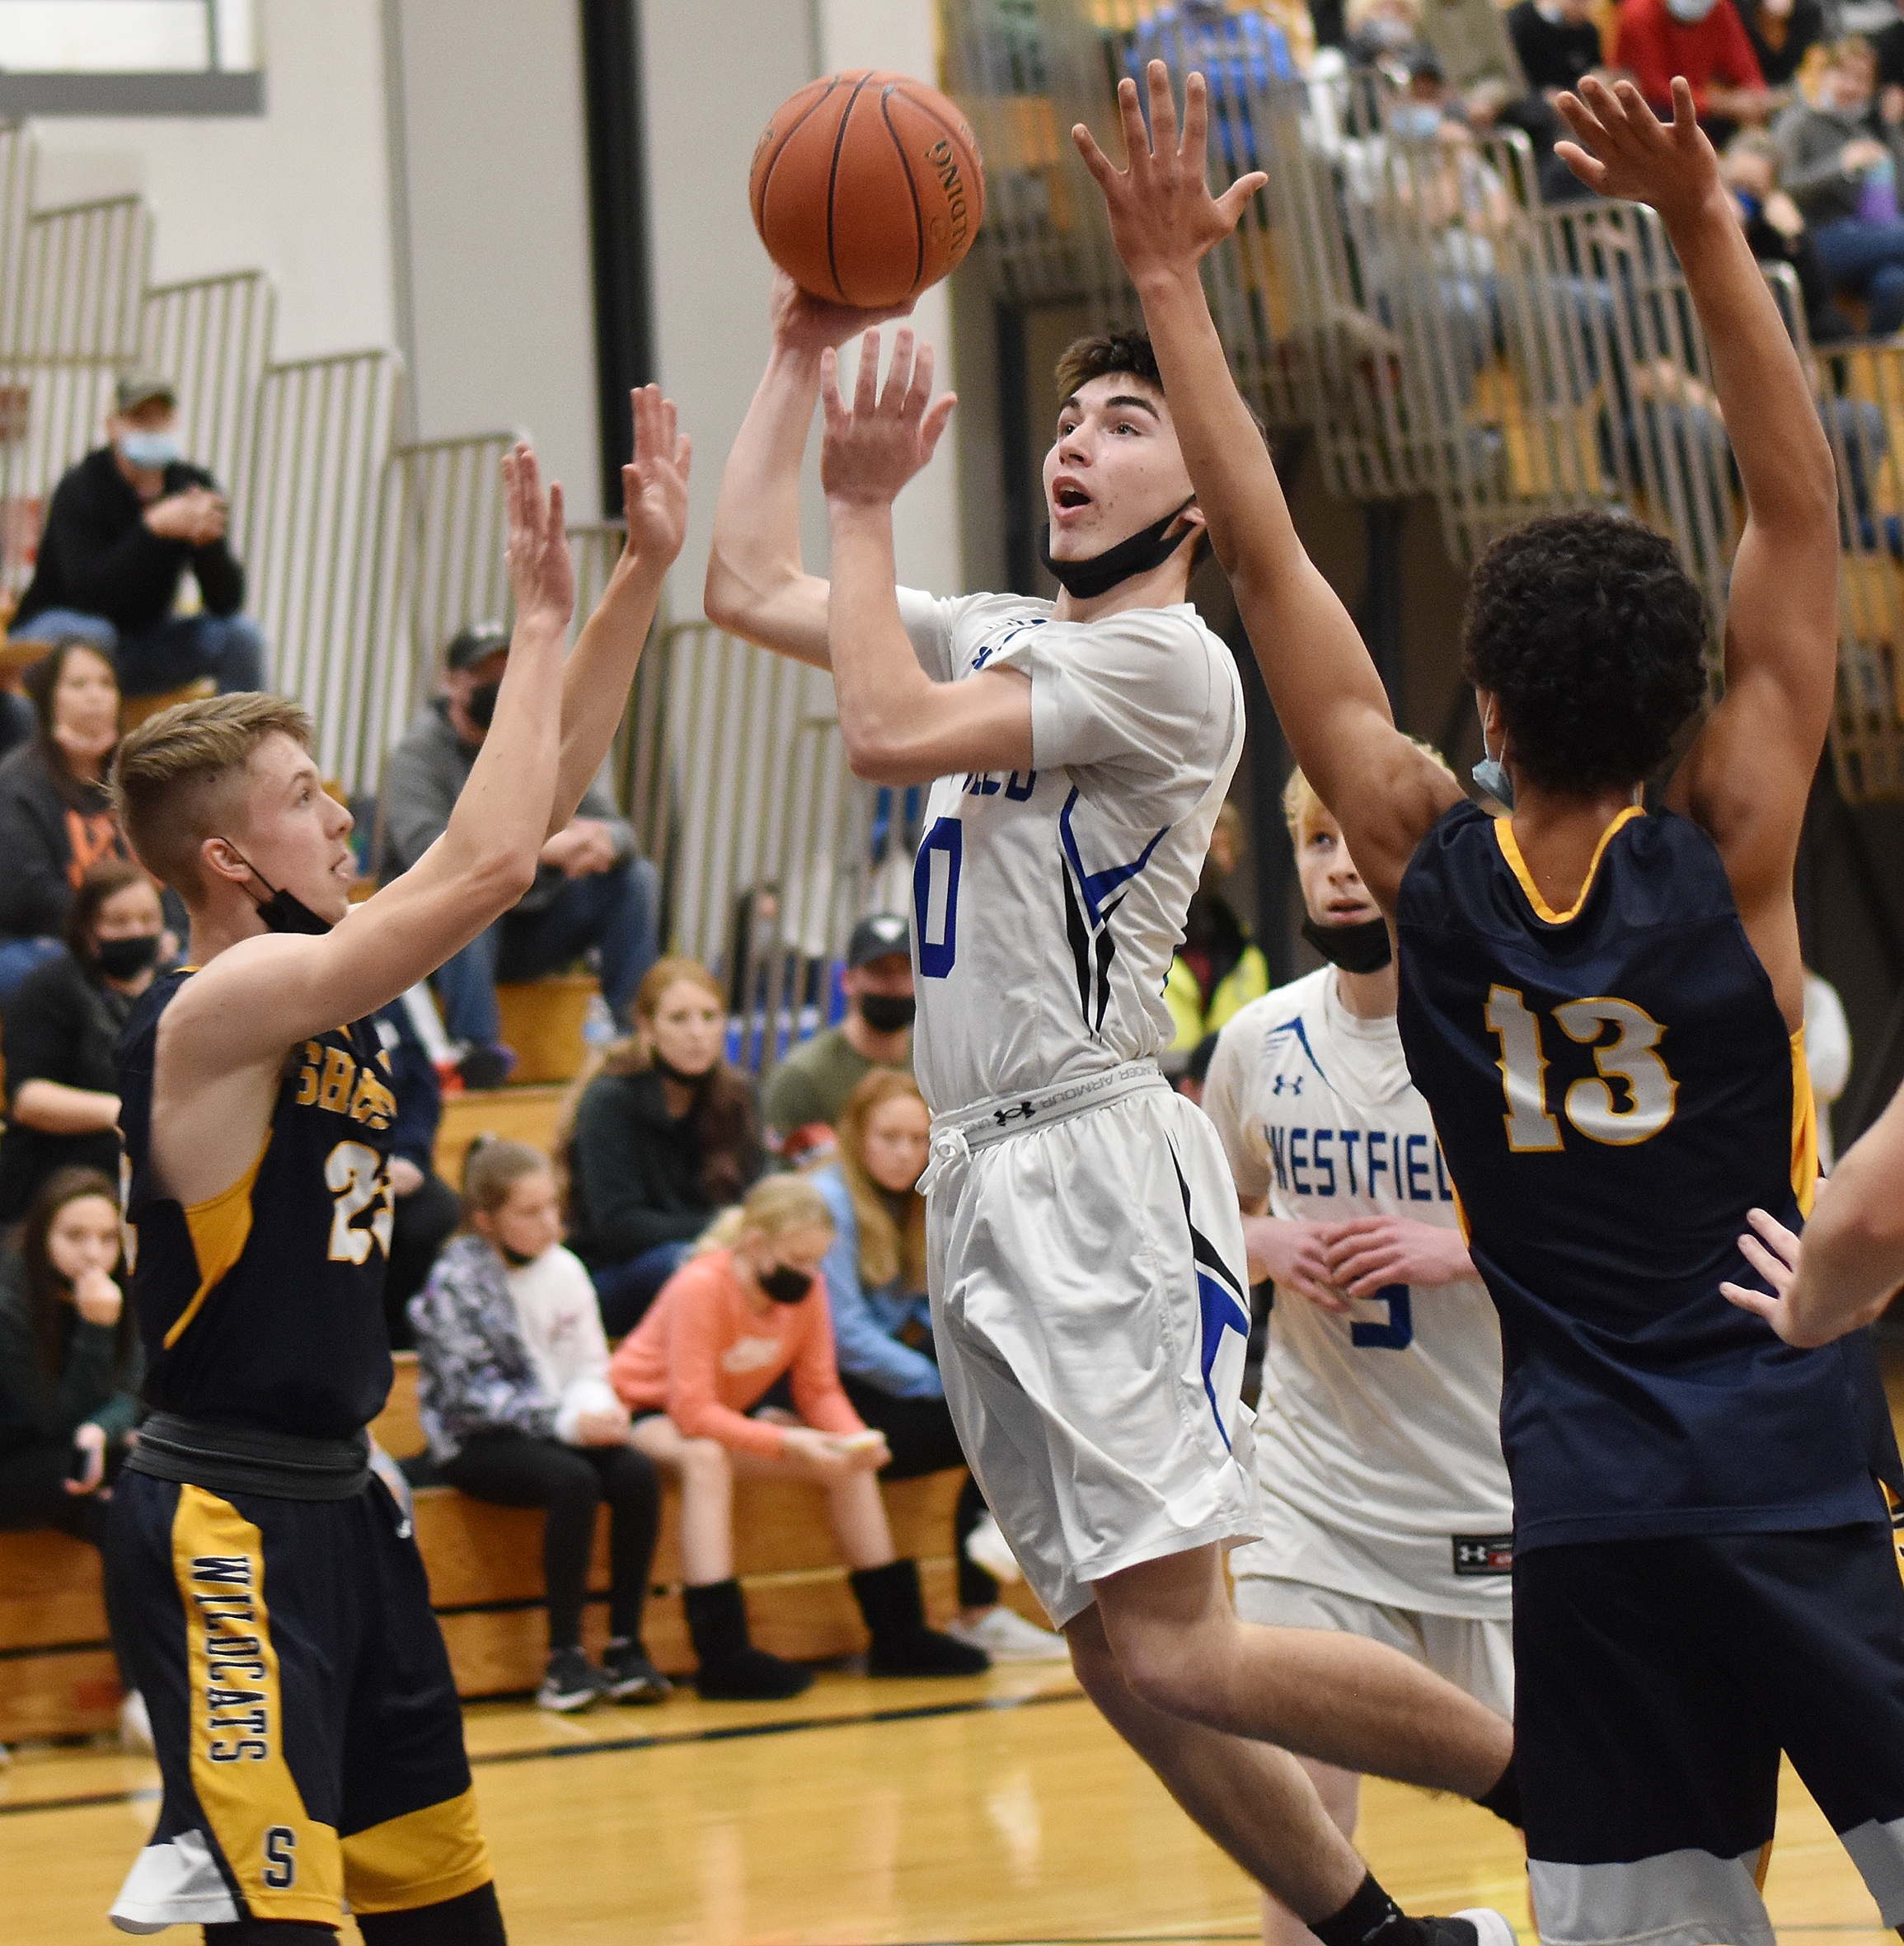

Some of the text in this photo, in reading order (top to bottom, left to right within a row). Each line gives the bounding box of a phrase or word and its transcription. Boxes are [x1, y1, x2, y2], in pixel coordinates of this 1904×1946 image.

[1039, 1076, 1114, 1108] ARMOUR
[1484, 982, 1681, 1153] 13
[191, 1554, 270, 1764] WILDCATS
[262, 1826, 298, 1890] S
